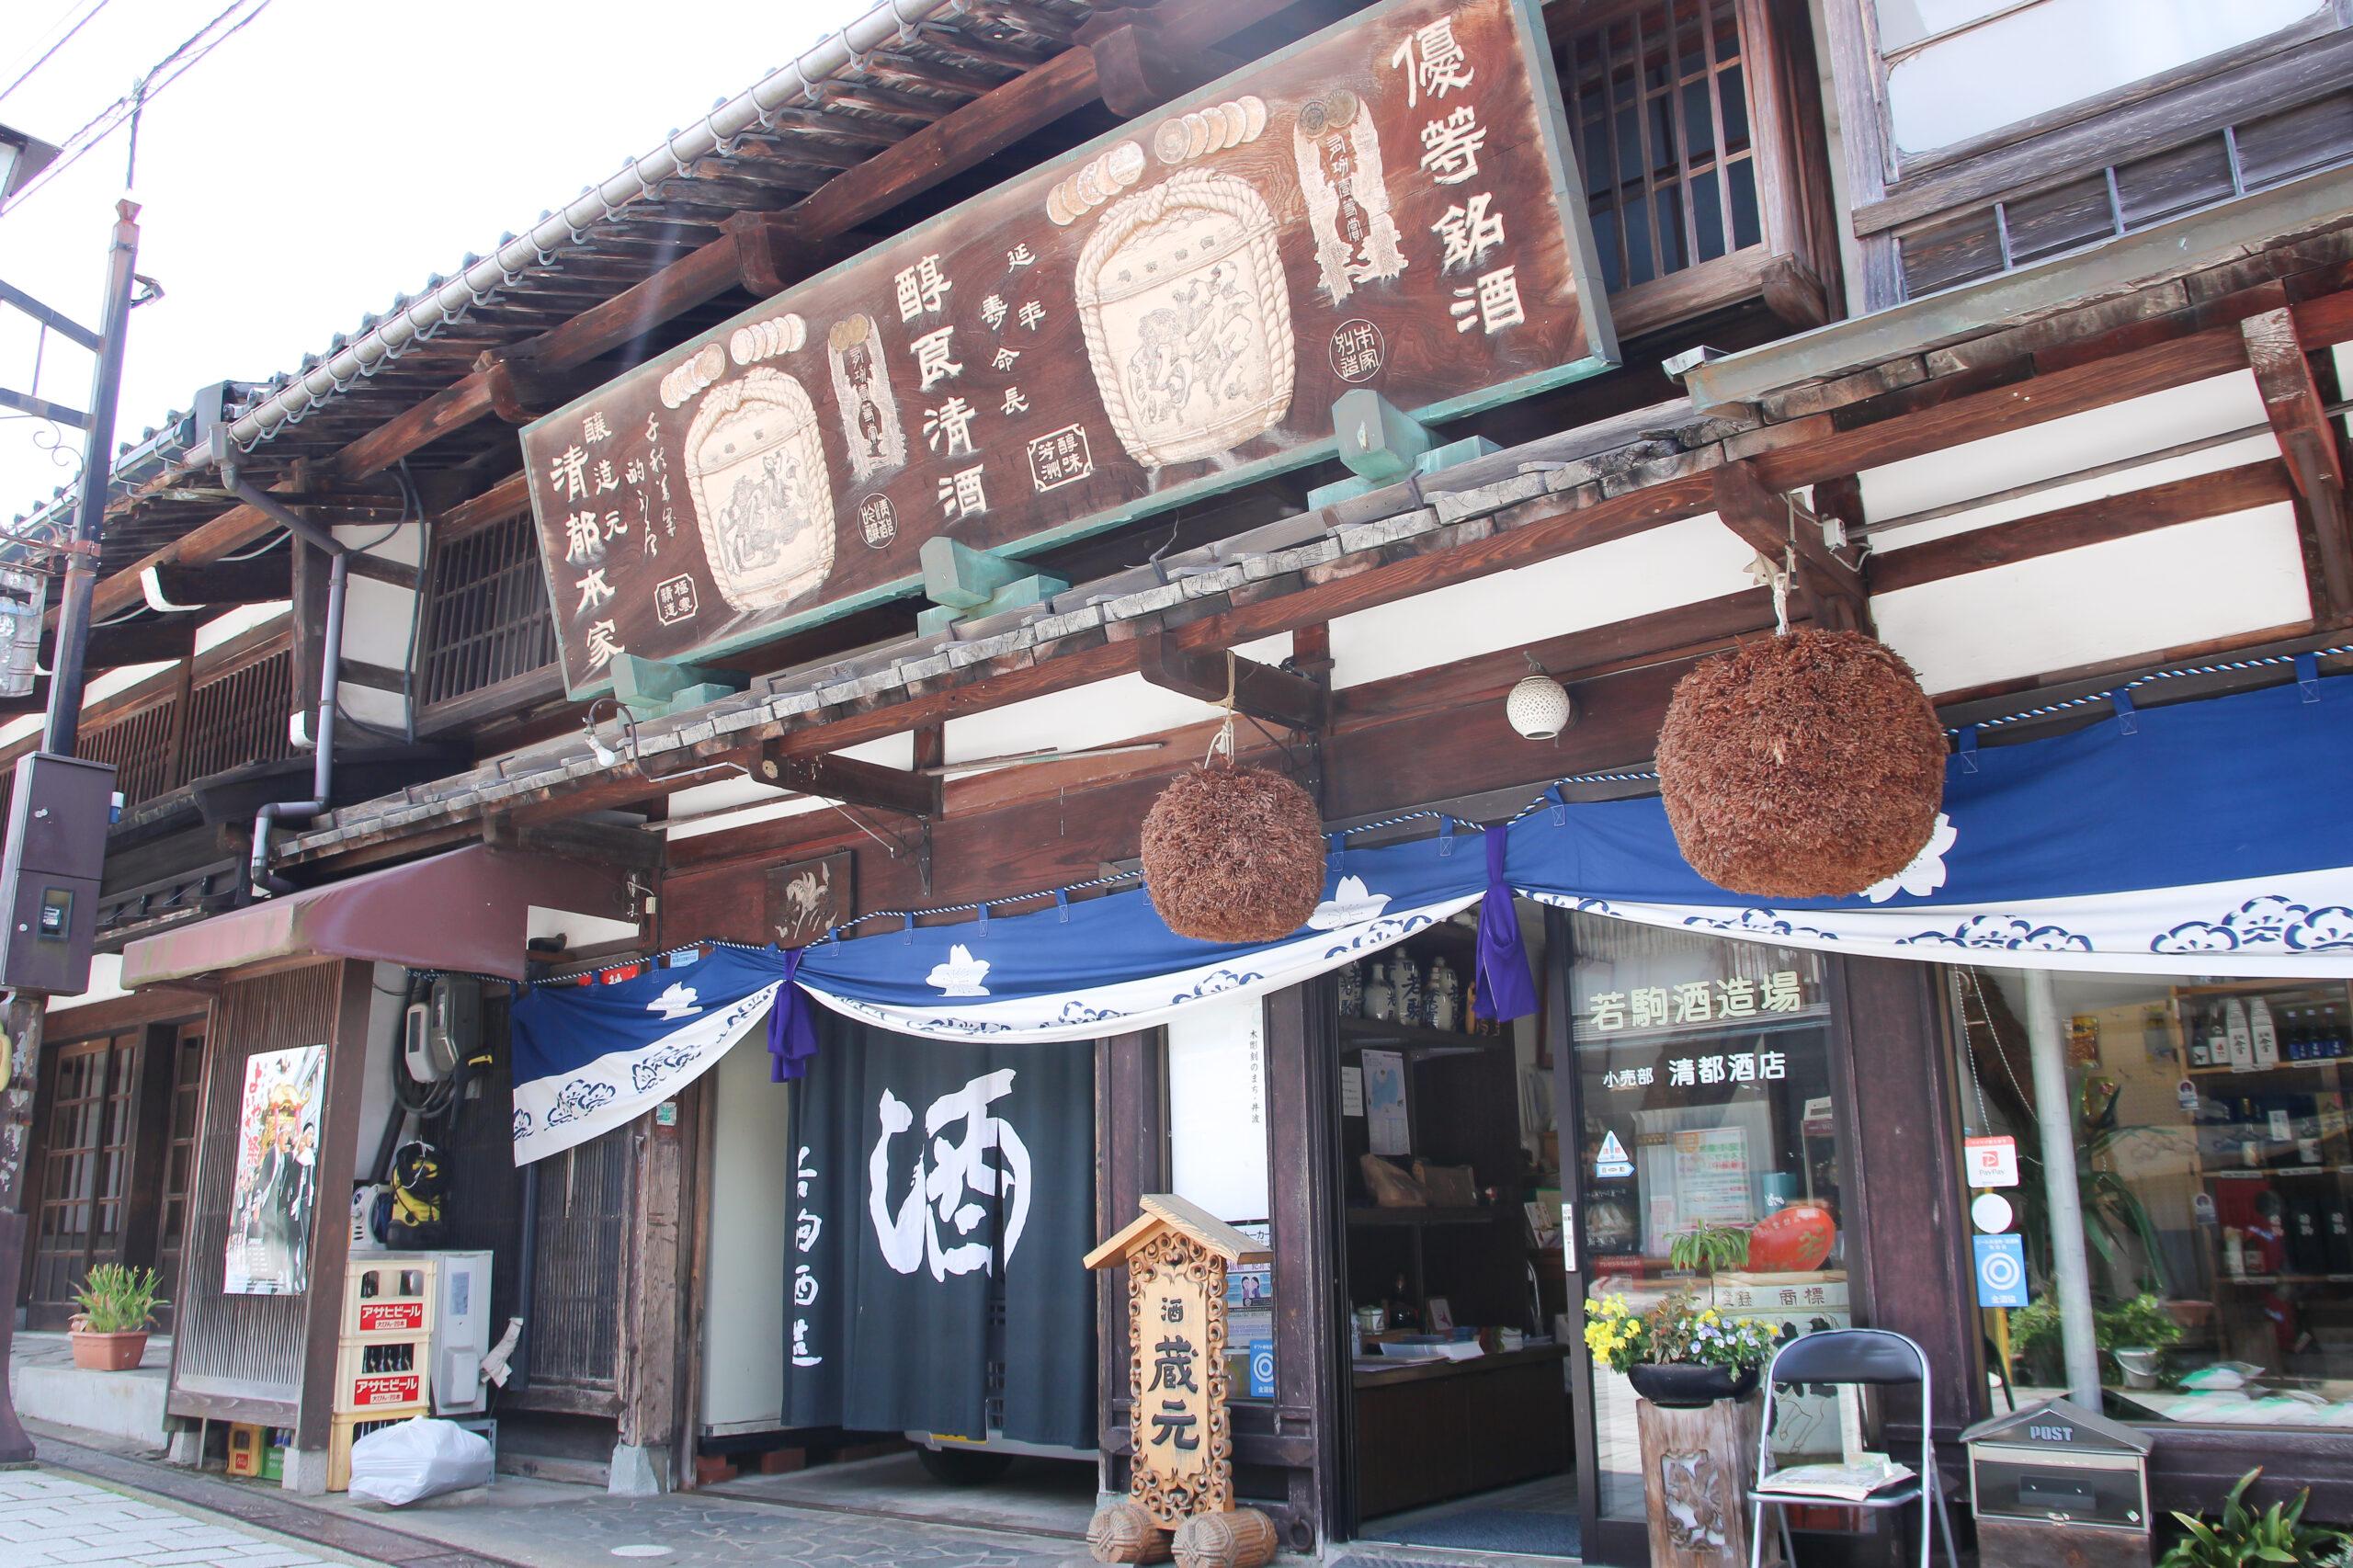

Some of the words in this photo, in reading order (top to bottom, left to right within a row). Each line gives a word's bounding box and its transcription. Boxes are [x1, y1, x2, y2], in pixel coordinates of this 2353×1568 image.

[1392, 16, 1525, 335] 優等銘酒
[550, 445, 625, 670] 清都本家
[1589, 971, 1802, 1030] 若駒酒造場
[1603, 1067, 1654, 1088] 小売部
[1668, 1051, 1786, 1086] 清都酒店
[870, 1068, 1031, 1283] 酒
[362, 1305, 421, 1319] アサヒビール
[357, 1378, 417, 1393] アサヒビール
[1147, 1297, 1200, 1450] 酒蔵元
[2029, 1426, 2074, 1441] POST
